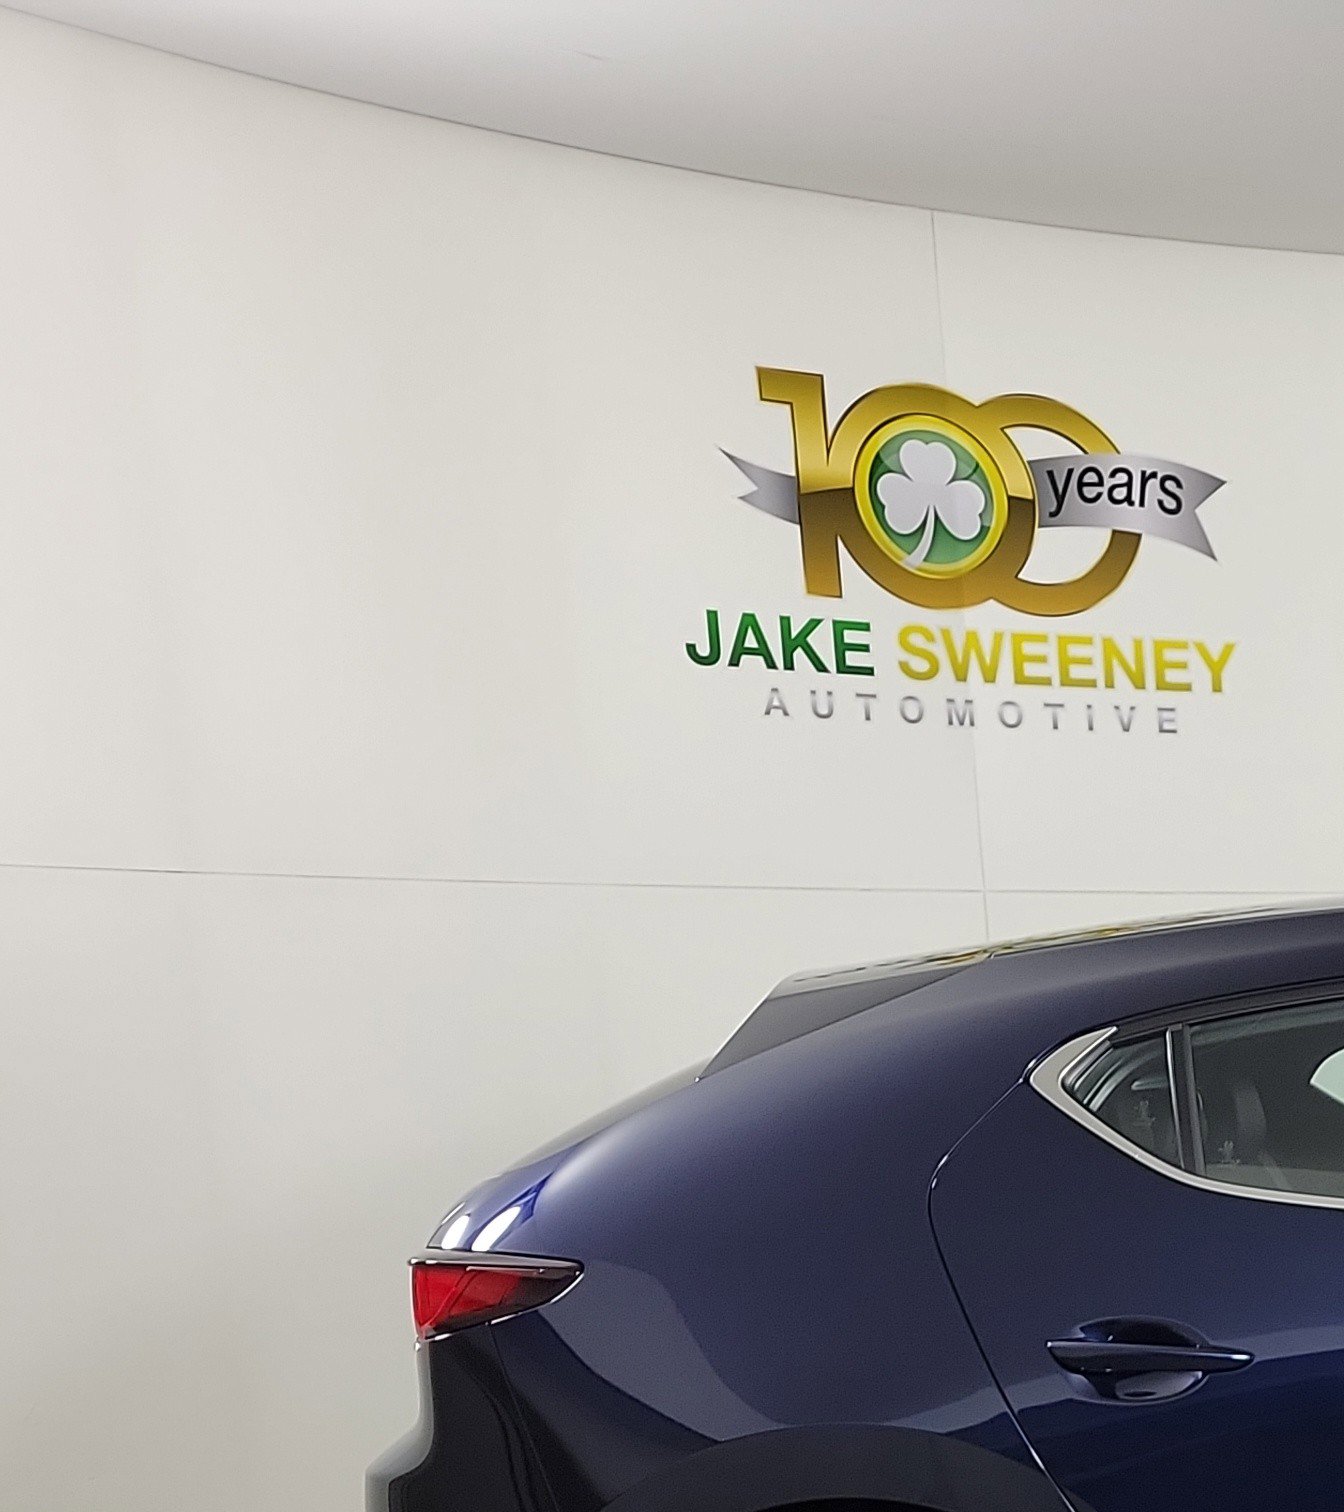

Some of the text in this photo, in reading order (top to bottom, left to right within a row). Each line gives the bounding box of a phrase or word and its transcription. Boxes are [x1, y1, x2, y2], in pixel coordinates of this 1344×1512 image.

[755, 365, 1184, 617] 100 years
[685, 608, 1236, 693] JAKE SWEENEY
[764, 686, 1180, 734] AUTOMOTIVE
